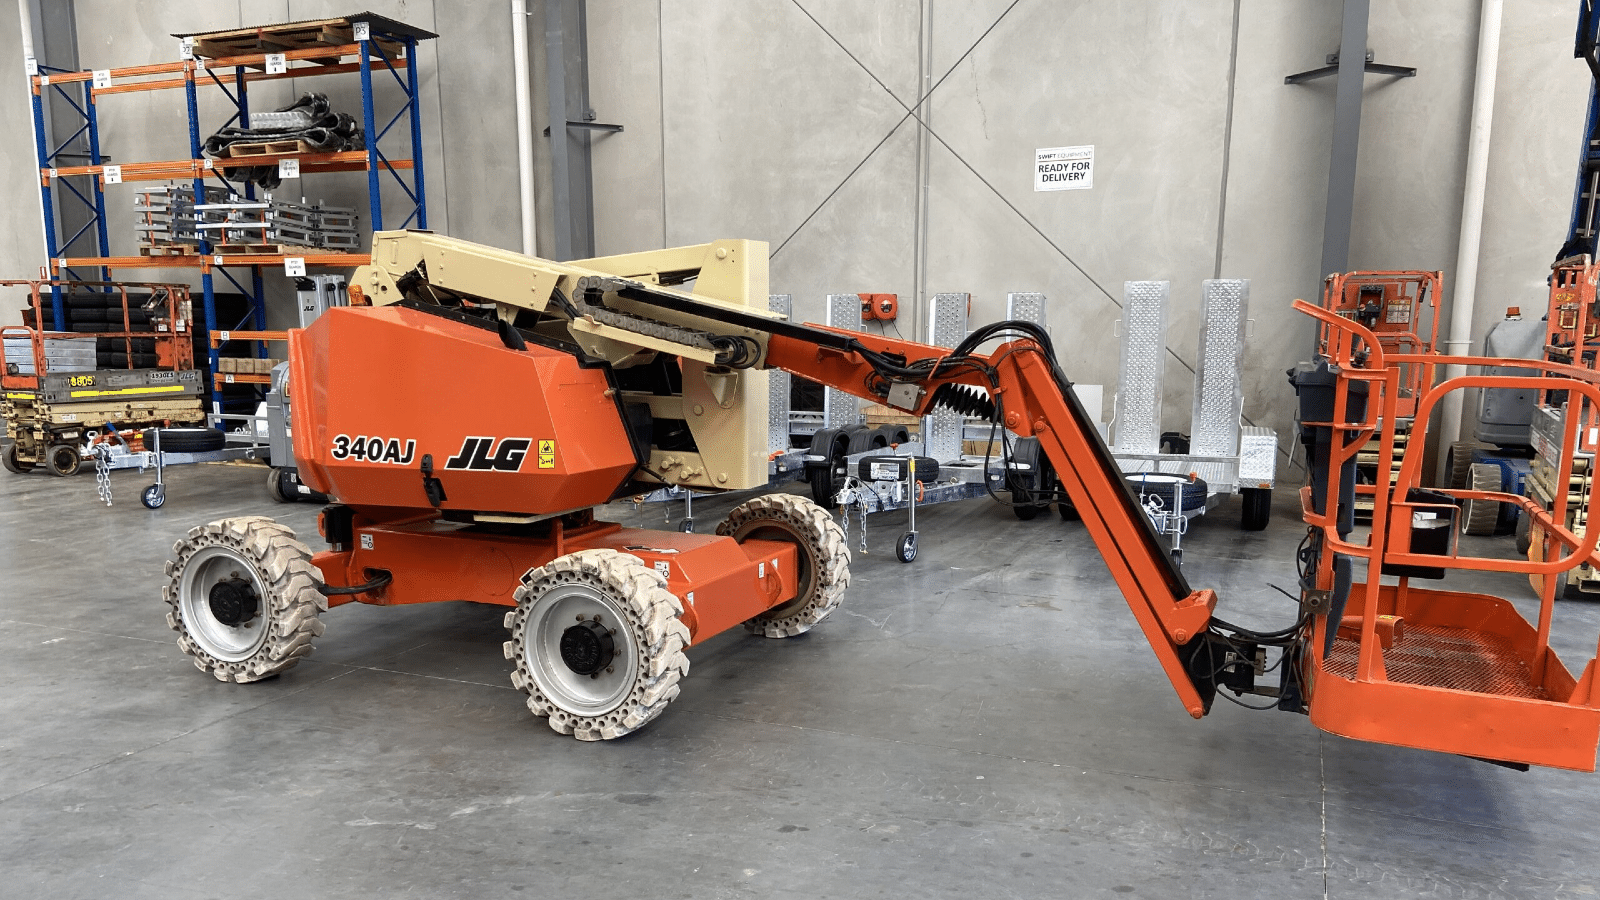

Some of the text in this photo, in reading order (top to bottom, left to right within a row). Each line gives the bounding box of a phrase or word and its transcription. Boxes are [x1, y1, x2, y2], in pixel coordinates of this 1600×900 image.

[1038, 162, 1090, 173] READY FOR
[1042, 172, 1086, 182] DELIVERY
[331, 434, 417, 465] 340AJ
[444, 435, 533, 473] JLG
